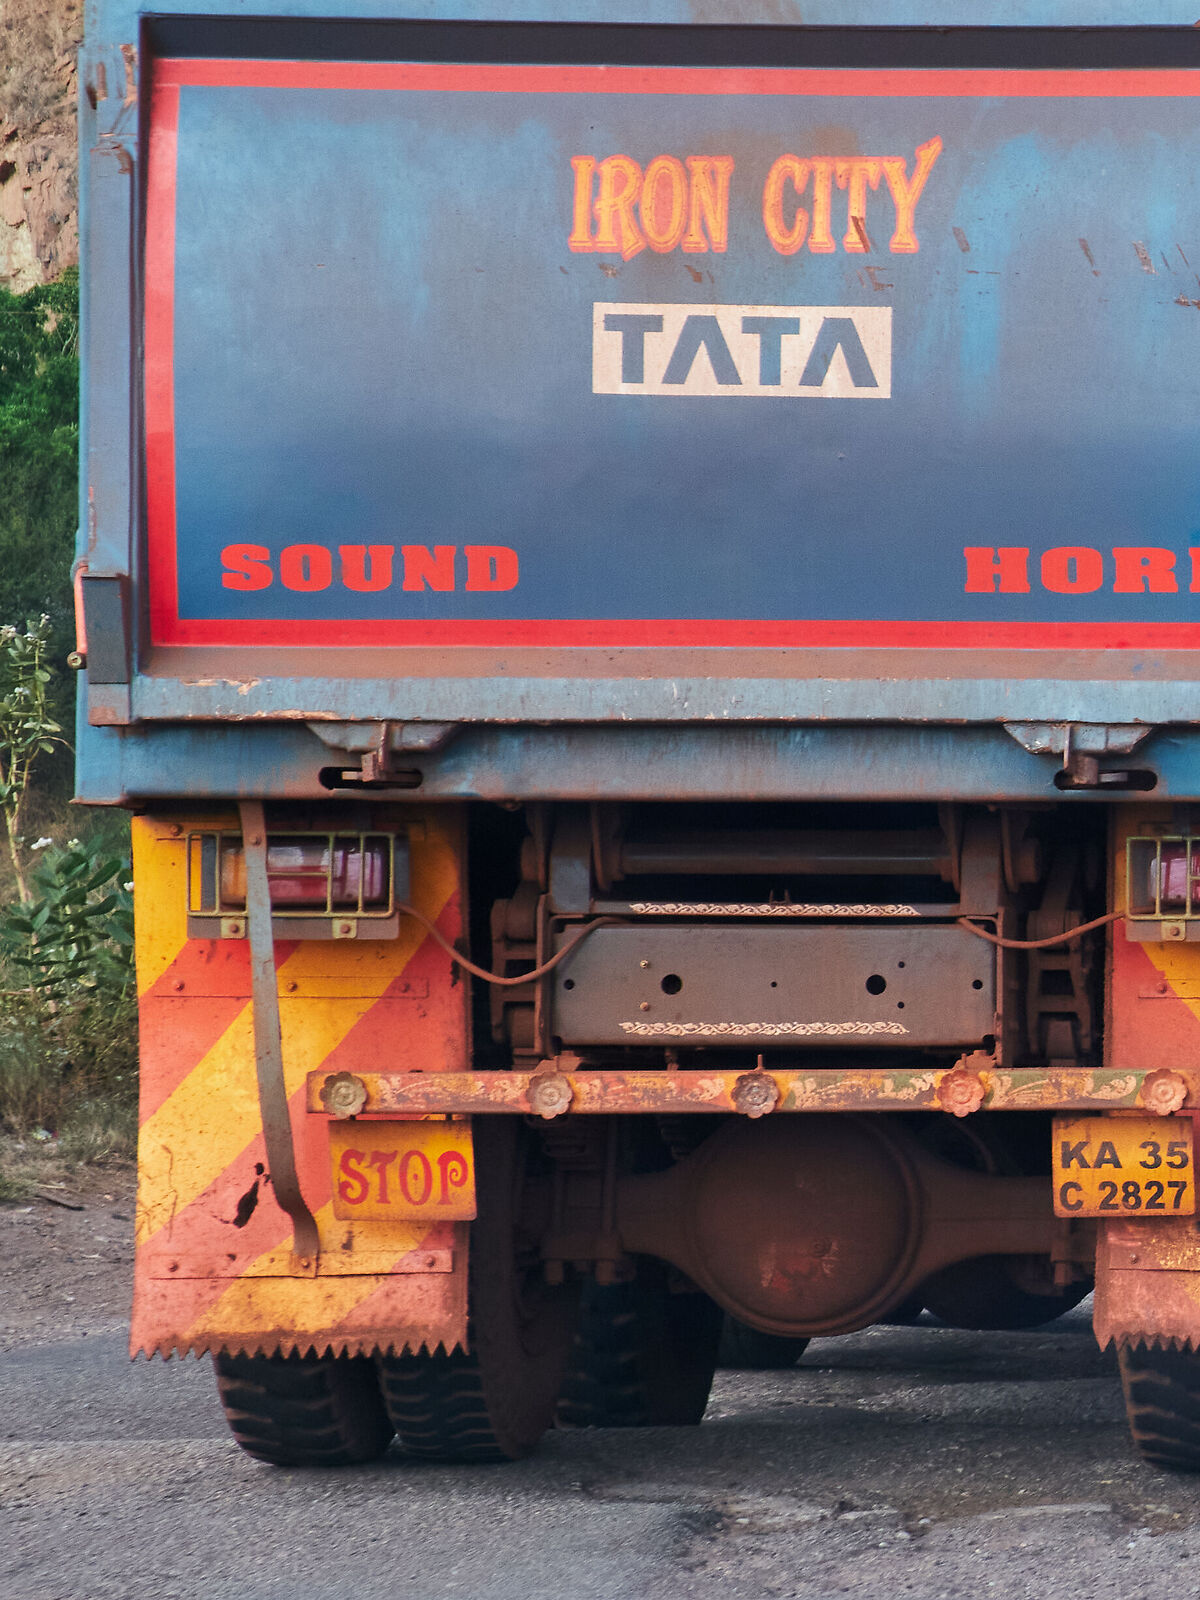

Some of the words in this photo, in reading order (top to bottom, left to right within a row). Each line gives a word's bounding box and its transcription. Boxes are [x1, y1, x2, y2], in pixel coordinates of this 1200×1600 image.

[568, 154, 735, 261] IRON
[762, 135, 943, 255] CITY
[604, 313, 879, 387] TATA
[220, 543, 519, 592] SOUND
[339, 1148, 469, 1205] STOP
[1061, 1141, 1122, 1169] KA
[1139, 1141, 1189, 1169] 35
[1059, 1182, 1084, 1210] C
[1097, 1180, 1188, 1210] 2827
